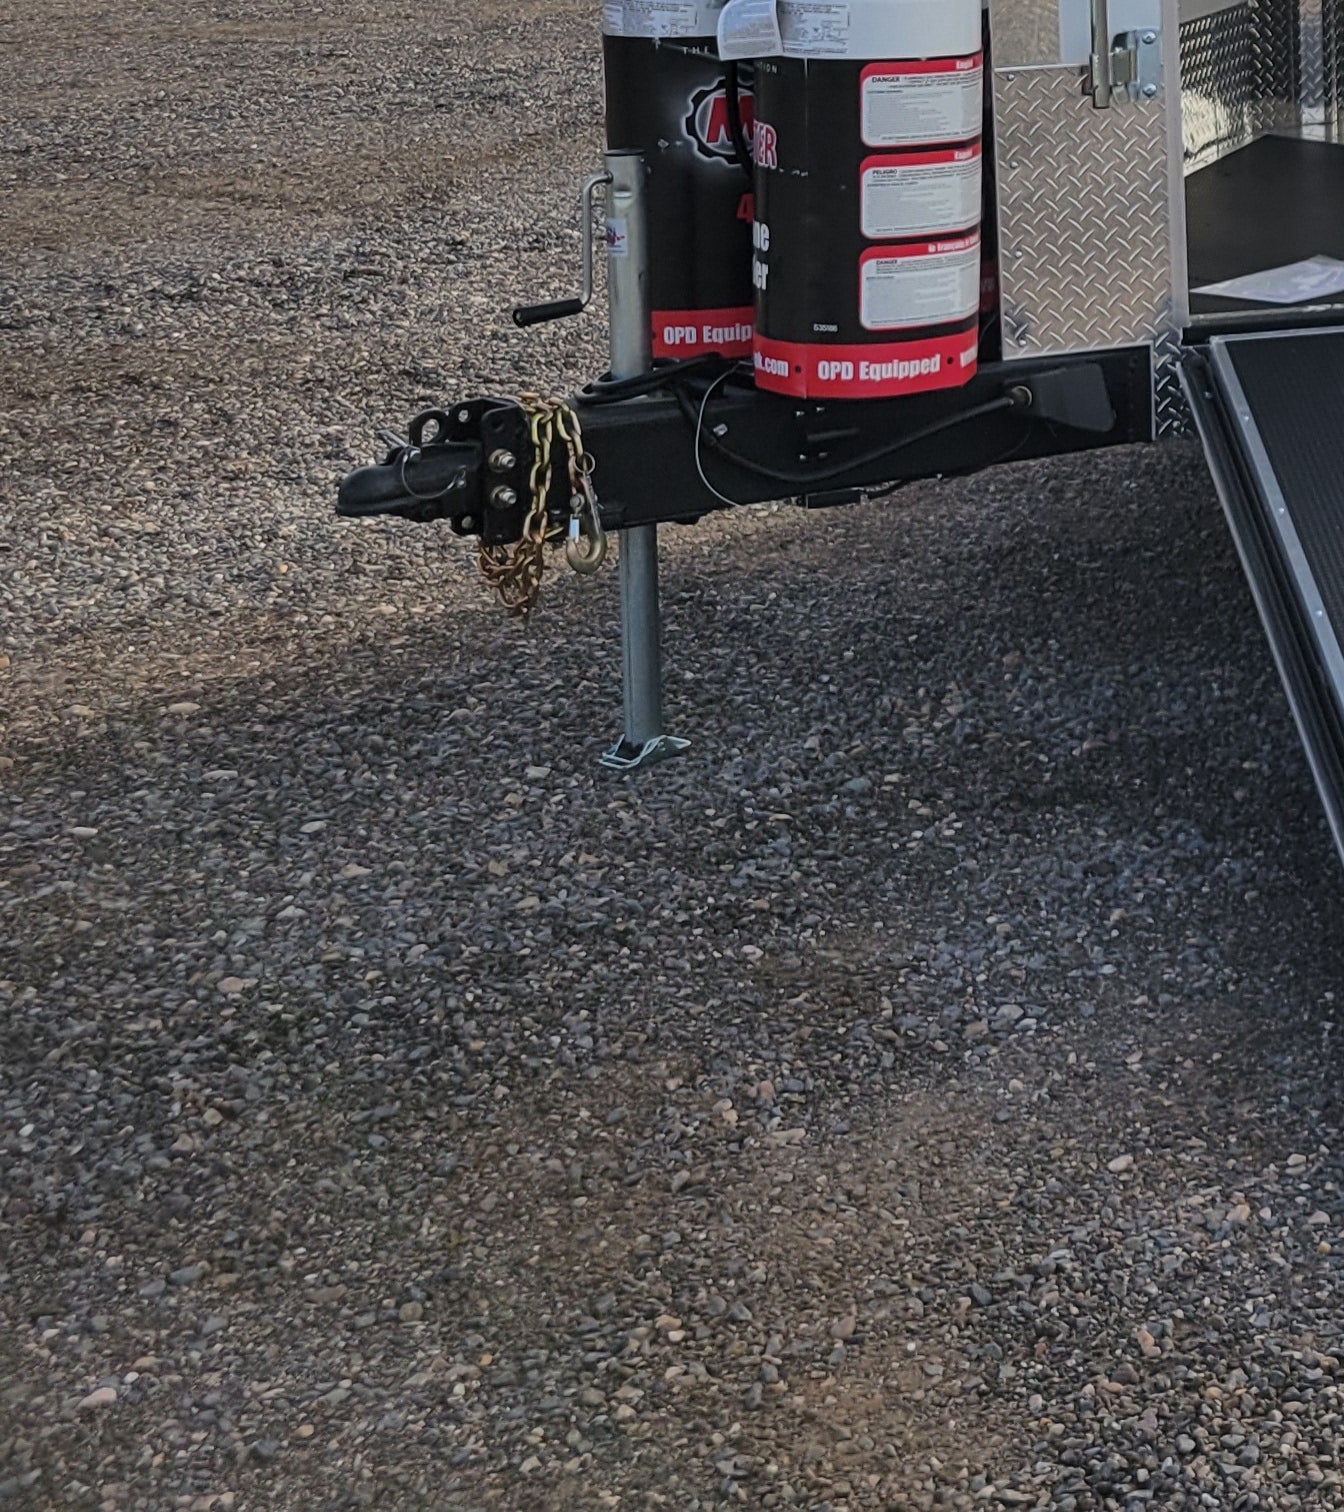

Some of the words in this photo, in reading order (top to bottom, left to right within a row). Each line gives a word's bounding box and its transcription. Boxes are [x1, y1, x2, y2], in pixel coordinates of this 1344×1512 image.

[663, 326, 697, 345] OPD
[702, 323, 753, 344] Equip
[817, 360, 854, 380] OPD
[859, 353, 941, 381] Equipped
